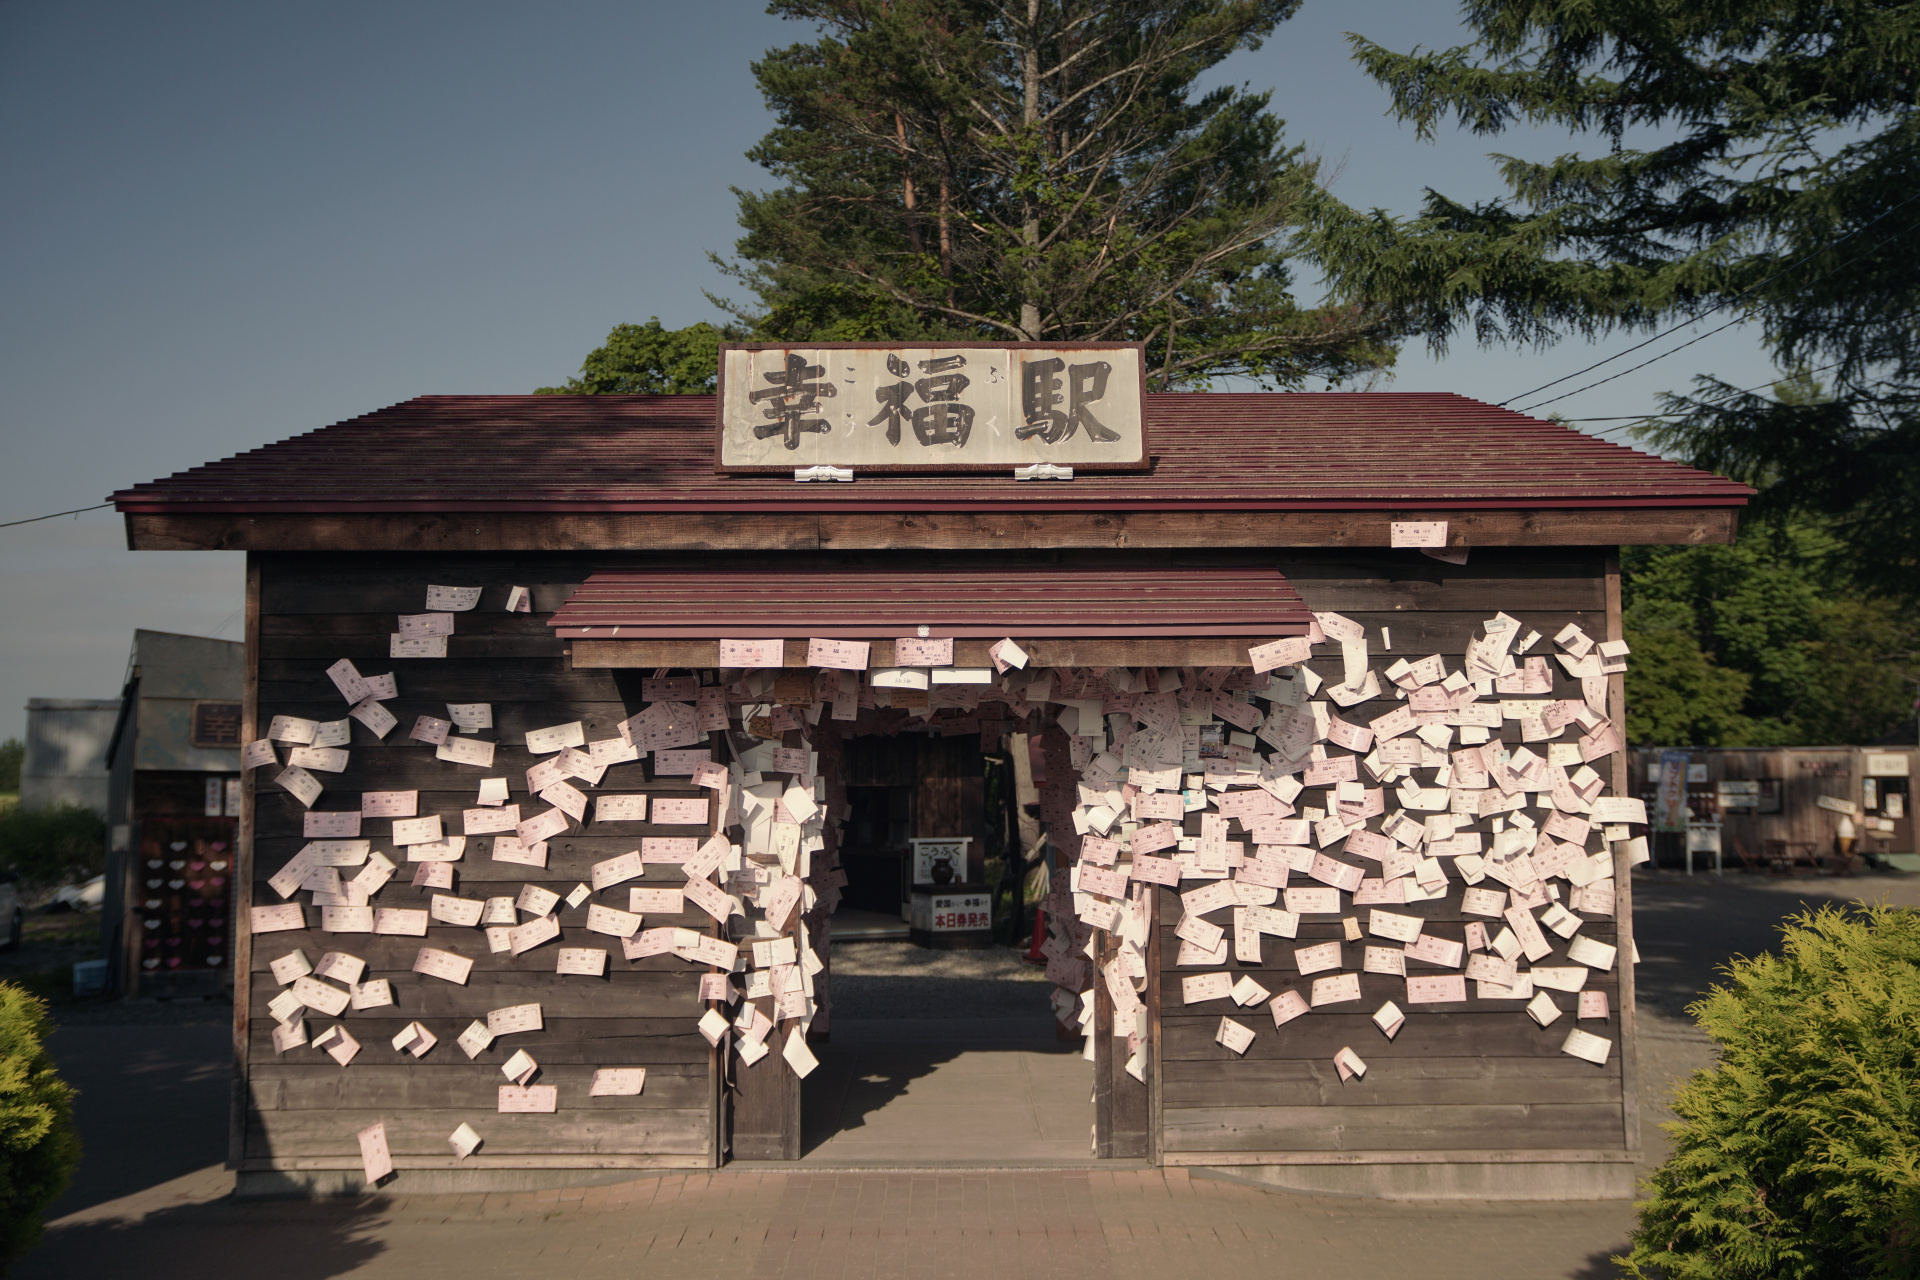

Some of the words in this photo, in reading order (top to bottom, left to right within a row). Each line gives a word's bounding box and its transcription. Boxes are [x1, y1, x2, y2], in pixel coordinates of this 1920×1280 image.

[749, 353, 1121, 450] 幸福駅
[920, 846, 960, 857] こうふく
